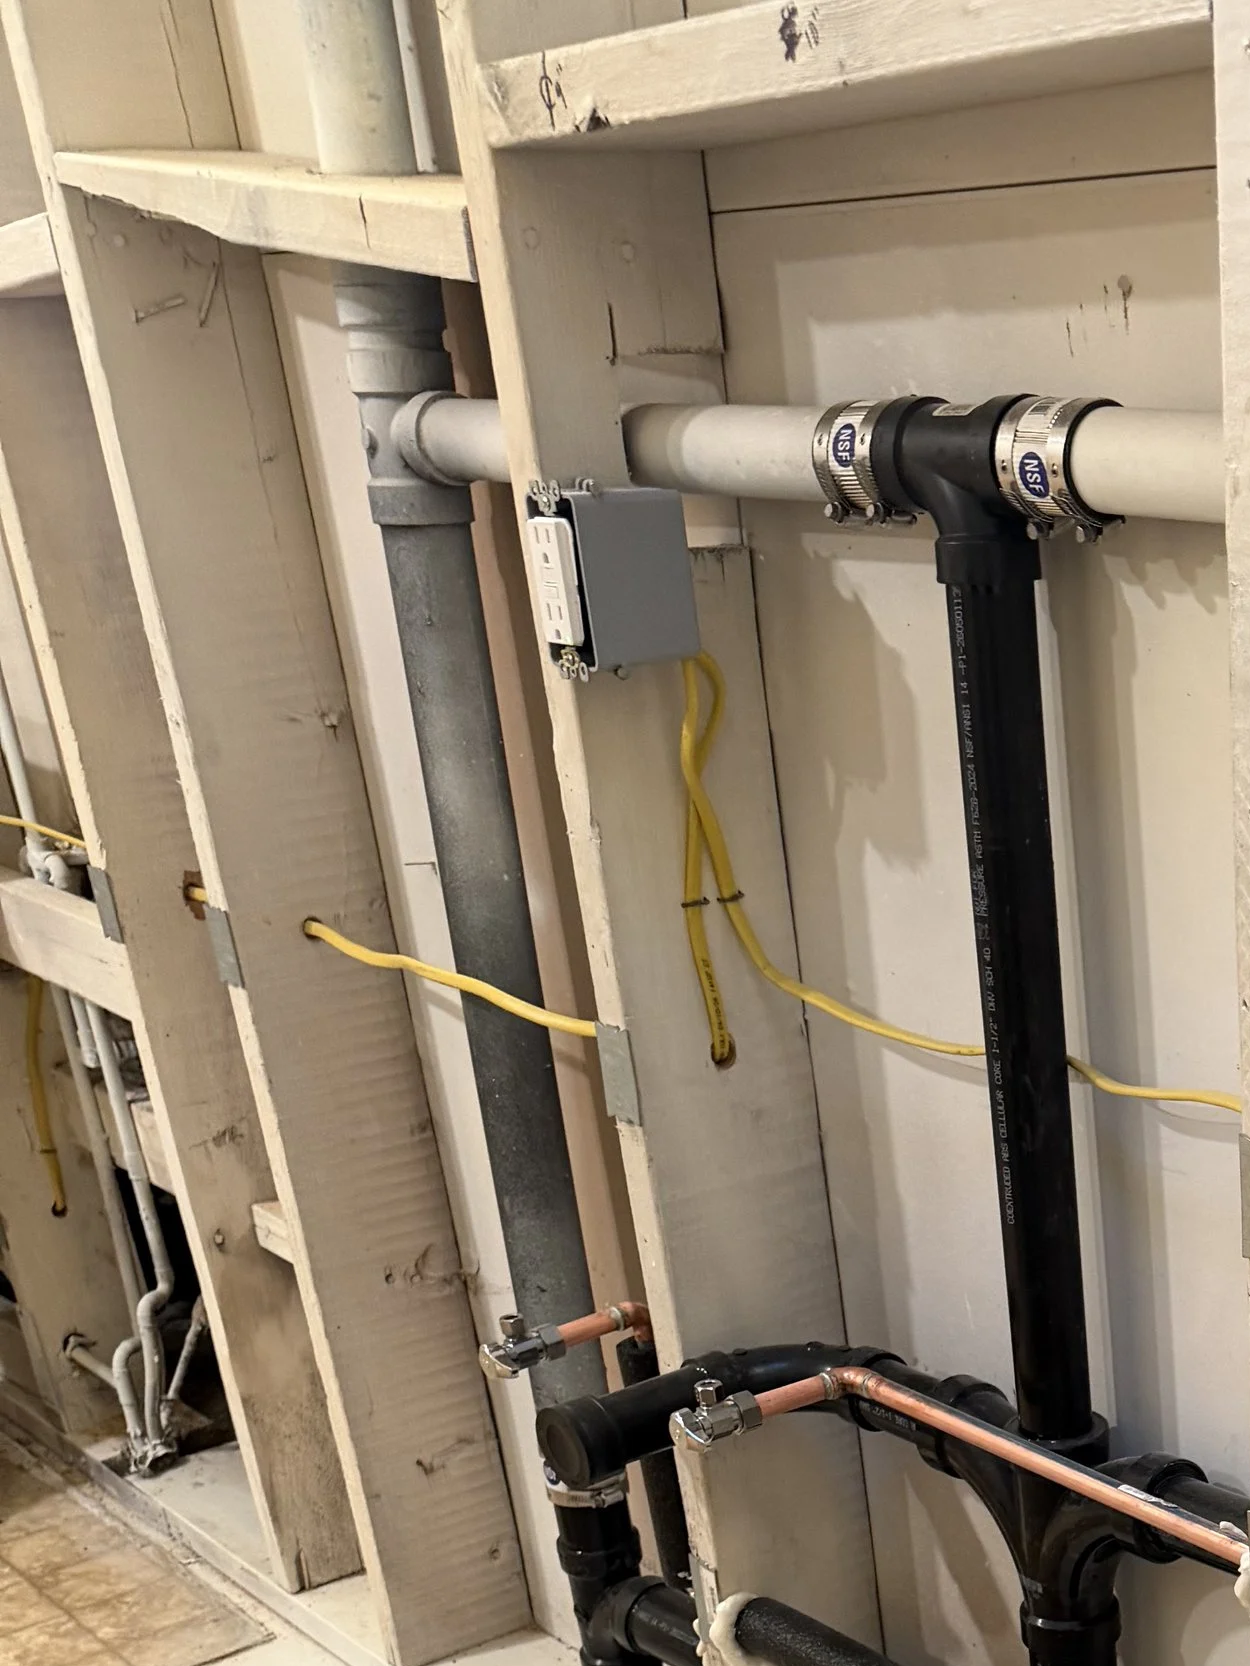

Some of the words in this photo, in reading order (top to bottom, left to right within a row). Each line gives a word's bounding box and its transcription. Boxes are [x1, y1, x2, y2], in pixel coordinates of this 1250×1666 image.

[837, 429, 853, 464] NSF
[1022, 459, 1046, 494] NSF
[960, 682, 969, 693] 14
[983, 948, 991, 960] 40
[985, 967, 994, 986] SCH
[993, 1061, 1003, 1084] CORE
[997, 1089, 1007, 1139] CELLULAR
